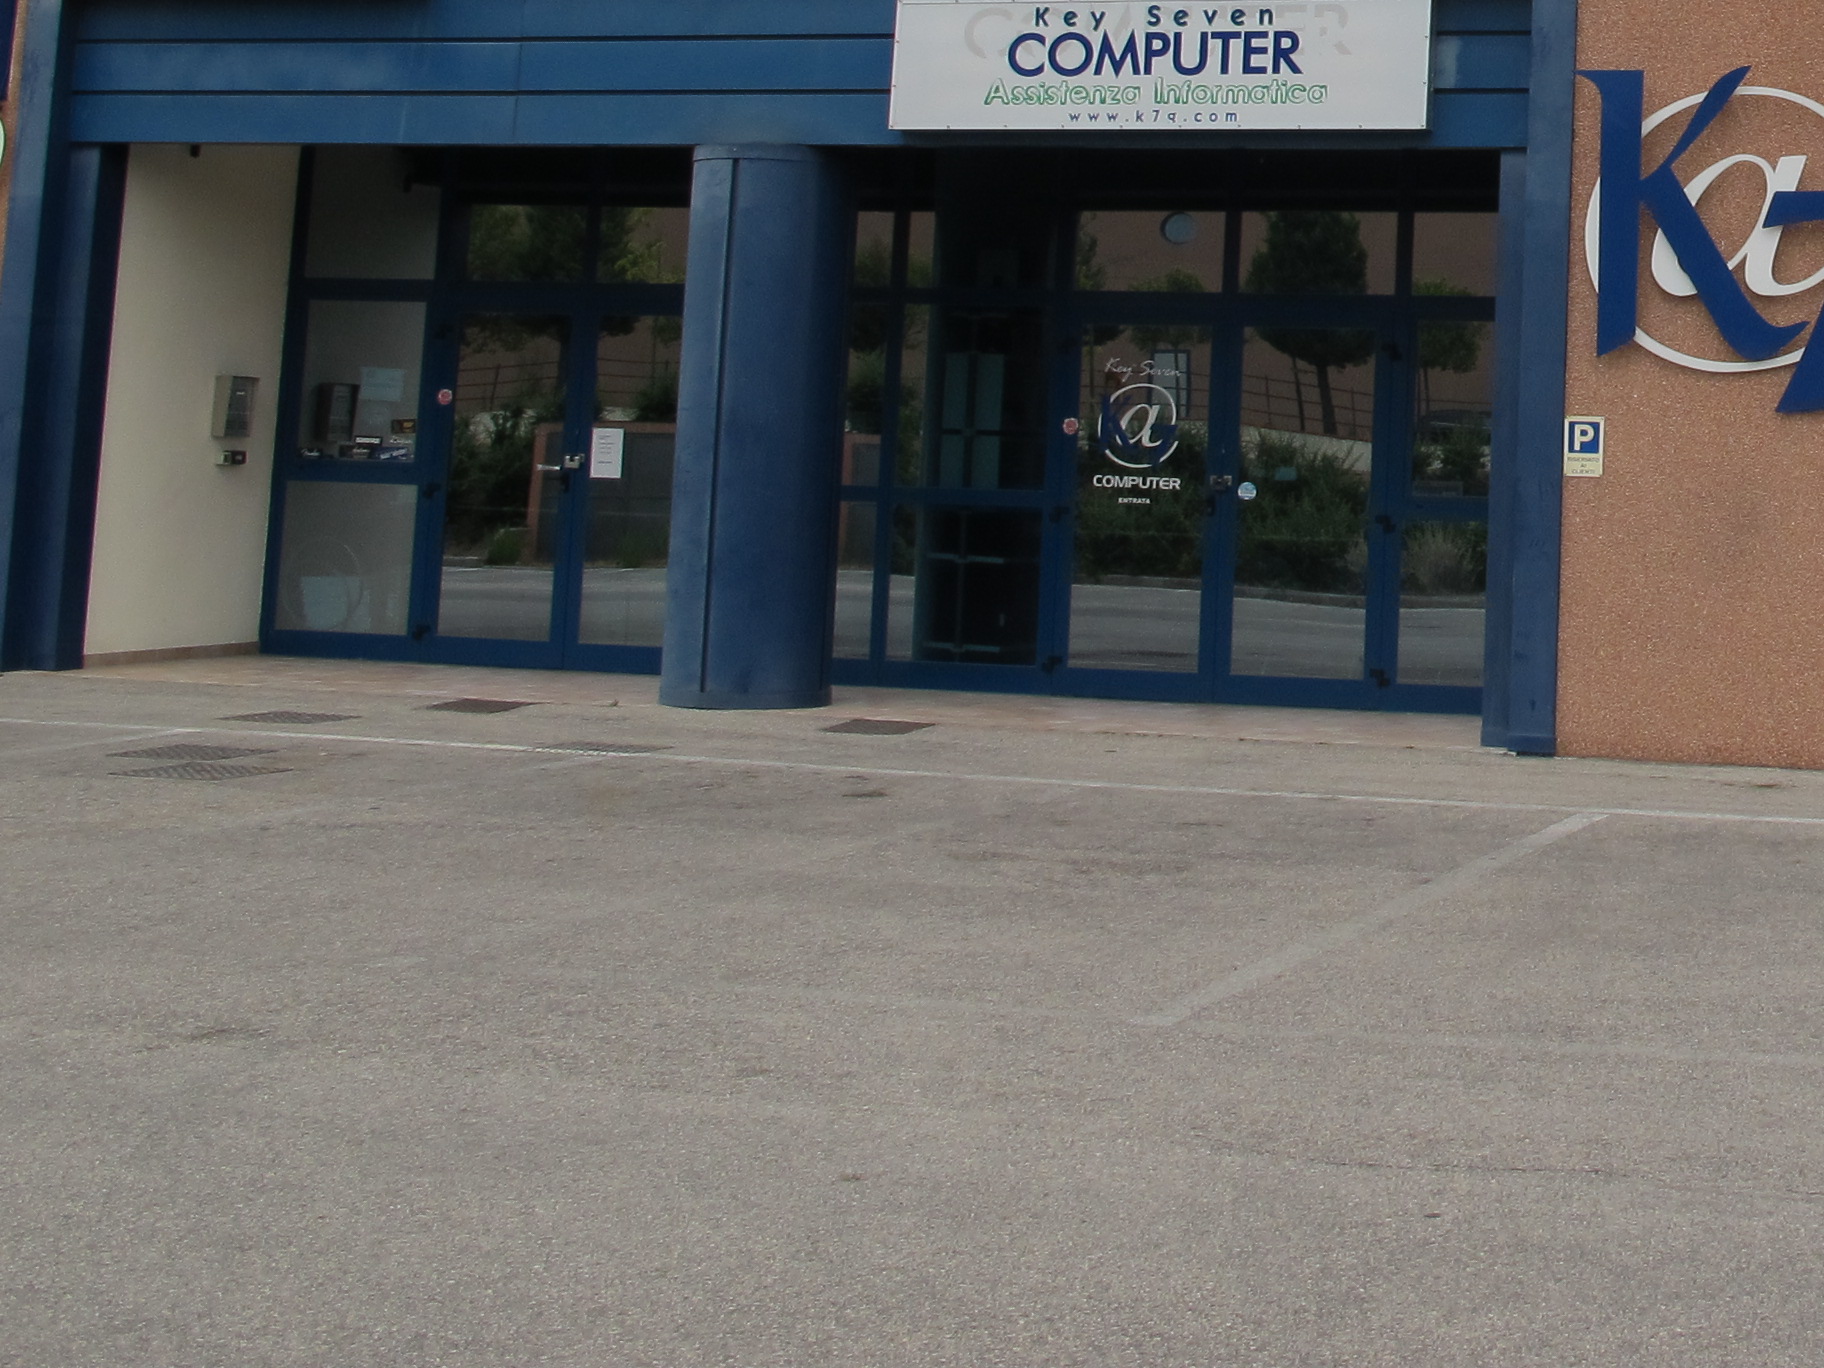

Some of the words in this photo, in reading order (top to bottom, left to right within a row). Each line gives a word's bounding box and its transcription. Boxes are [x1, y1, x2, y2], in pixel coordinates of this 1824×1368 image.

[1034, 6, 1107, 31] Key
[1146, 4, 1275, 27] Seven
[1007, 29, 1304, 78] COMPUTER
[983, 78, 1141, 105] Assistenza
[1153, 76, 1329, 105] Informatica
[1104, 357, 1134, 382] Key
[1139, 360, 1184, 377] Seven
[1573, 423, 1595, 451] P
[1093, 474, 1181, 491] COMPUTER
